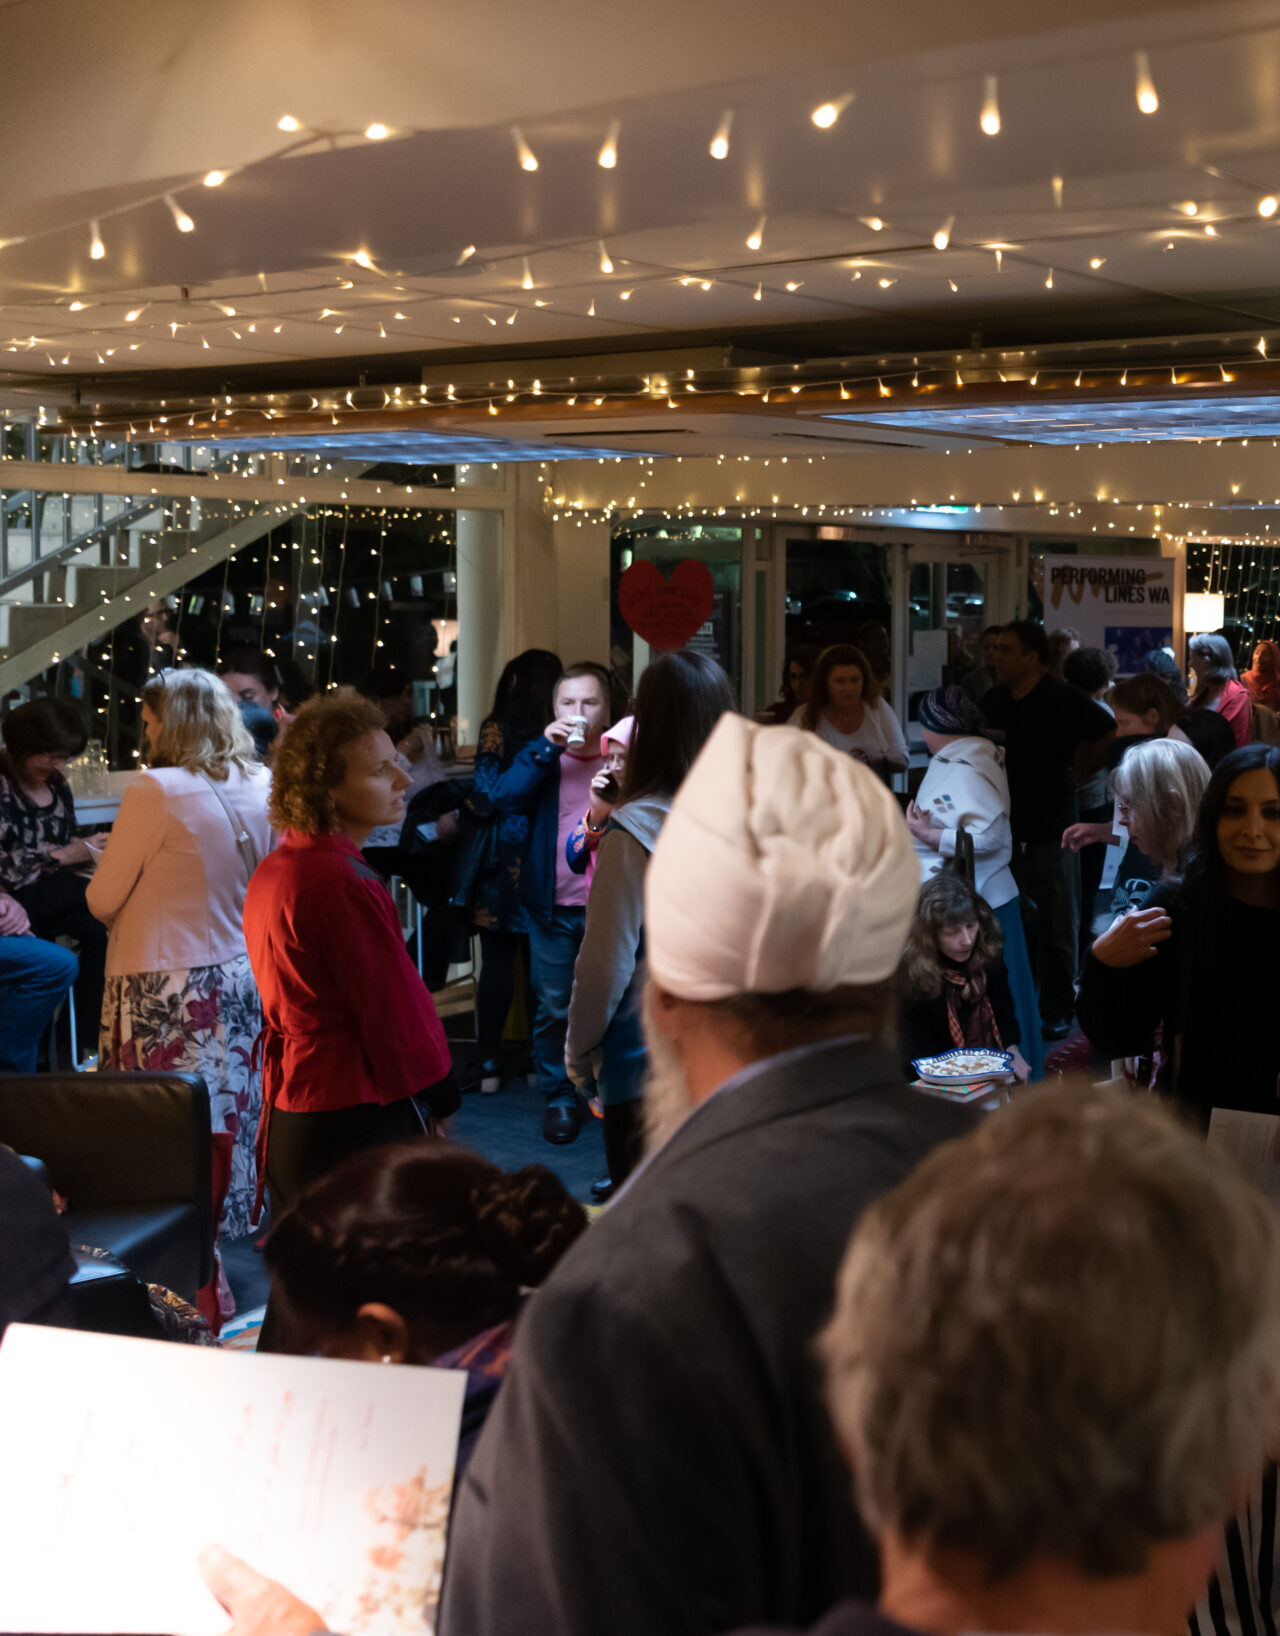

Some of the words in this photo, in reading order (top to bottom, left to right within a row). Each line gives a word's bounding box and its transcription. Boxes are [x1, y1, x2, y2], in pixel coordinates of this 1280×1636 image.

[1051, 567, 1145, 585] PERFORMING
[1105, 586, 1144, 603] LINES
[1149, 587, 1170, 604] WA
